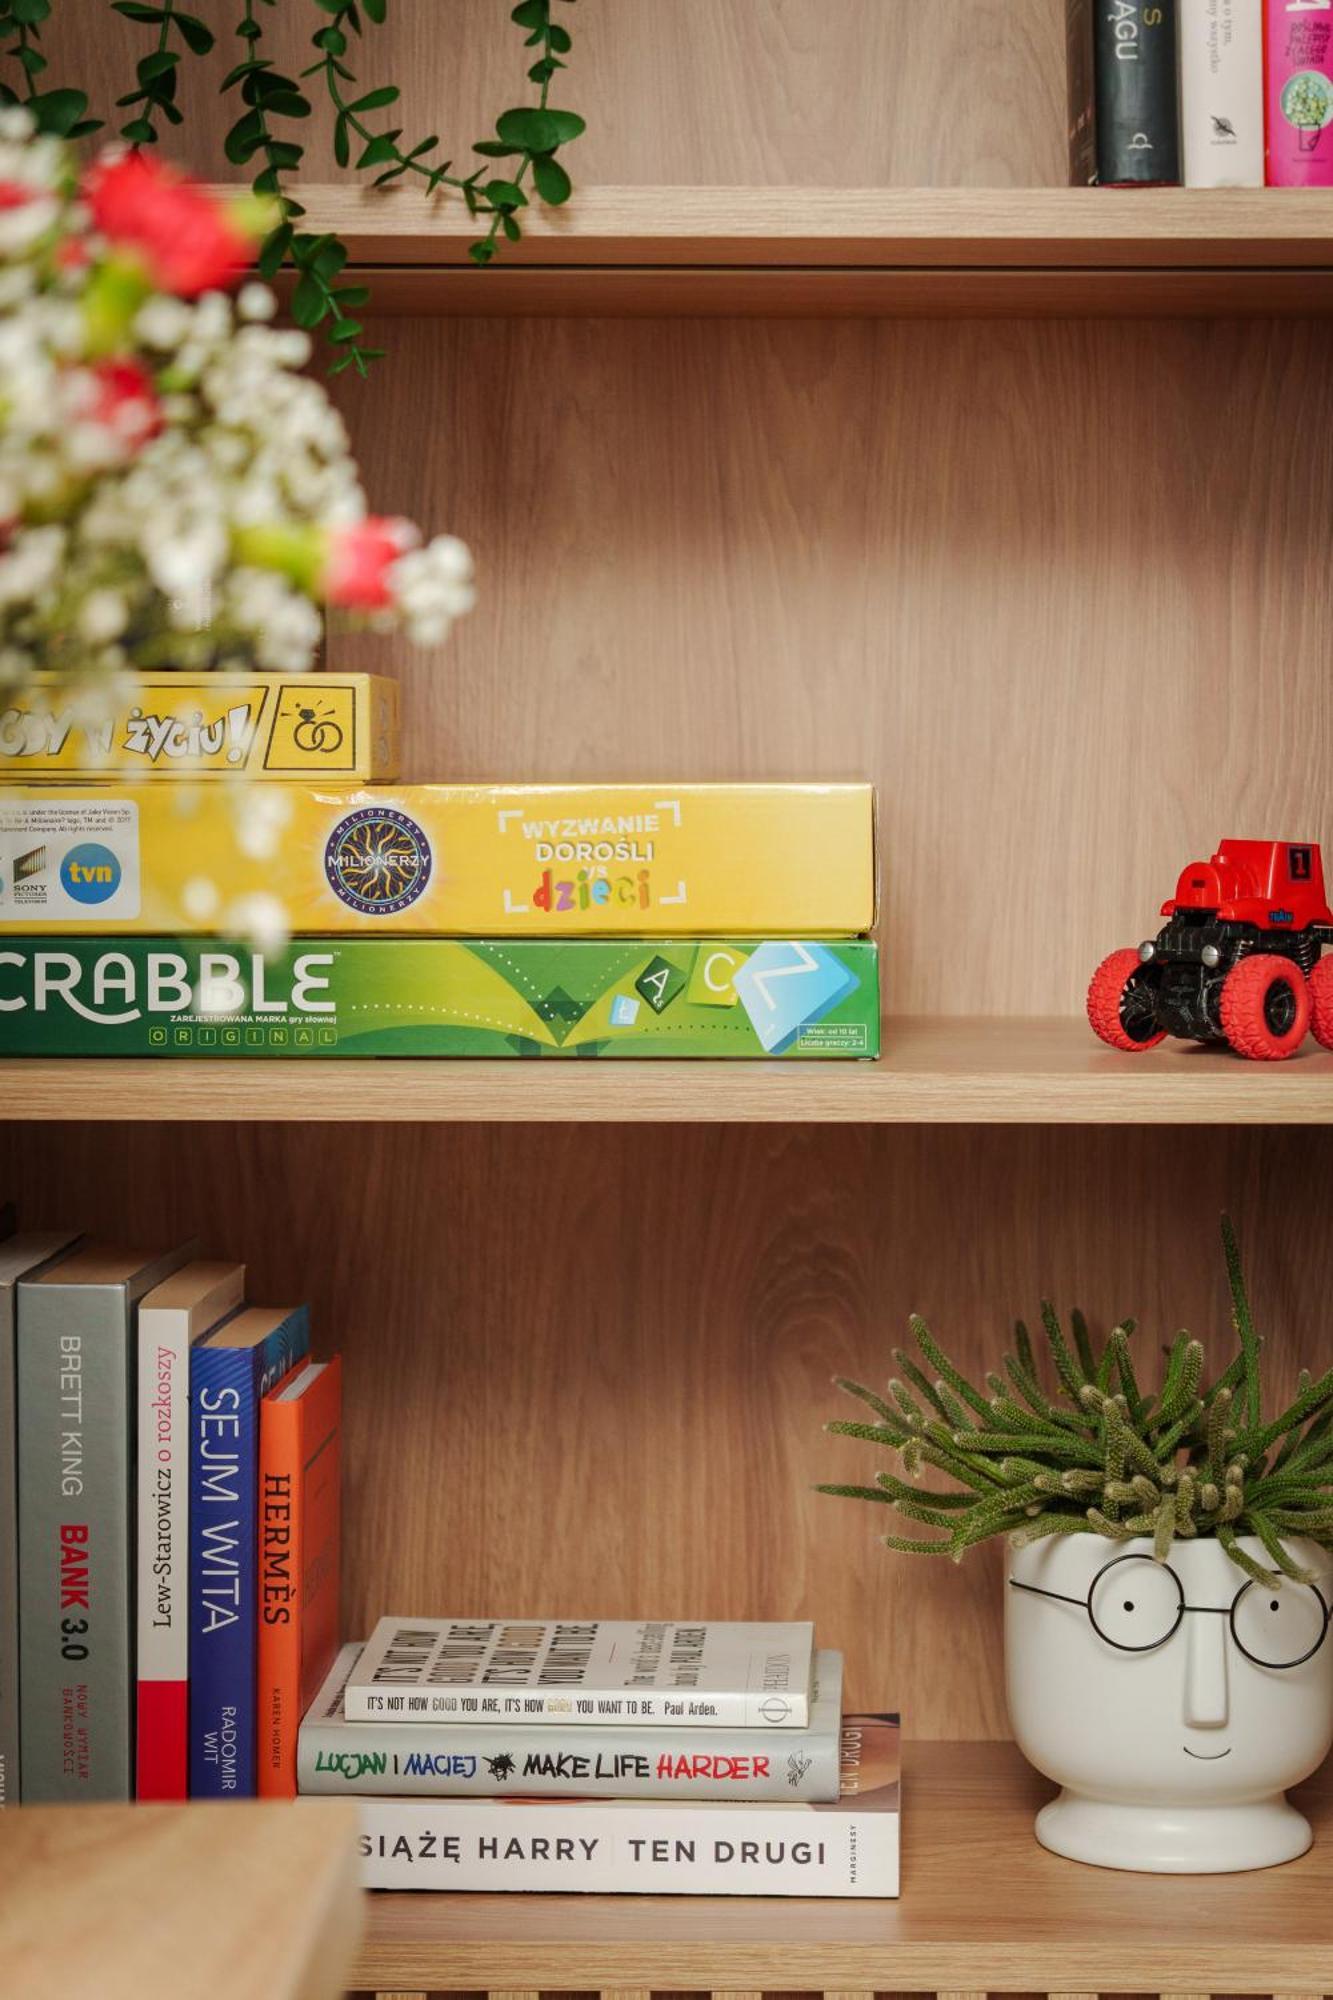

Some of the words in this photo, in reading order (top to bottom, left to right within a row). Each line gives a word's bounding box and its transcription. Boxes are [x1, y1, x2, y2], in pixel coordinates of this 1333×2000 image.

[336, 809, 420, 835] MILIONERZY
[522, 814, 660, 839] WYZWANIE
[327, 855, 430, 867] MILIONERZY
[535, 836, 655, 862] DOROŚLI
[13, 884, 47, 892] SONY
[69, 862, 112, 883] tvn
[533, 868, 650, 912] dzieci
[337, 887, 421, 913] MILIONERZY
[255, 1015, 287, 1023] MARKA
[288, 1015, 303, 1025] gry
[60, 1335, 82, 1424] BRETT
[151, 1345, 177, 1443] rozkoszy
[158, 1449, 172, 1462] o
[200, 1388, 240, 1501] SEJM
[61, 1432, 83, 1496] KING
[152, 1468, 172, 1629] Lew-Starowicz
[263, 1473, 297, 1625] HERMÈS
[60, 1524, 89, 1610] BANK
[201, 1520, 240, 1634] WITA
[61, 1618, 89, 1661] 3.0
[381, 1649, 431, 1665] NOT
[437, 1644, 488, 1660] YOU
[536, 1668, 587, 1685] YOU
[77, 1684, 89, 1719] NOWY
[272, 1687, 281, 1725] KAREN
[367, 1697, 383, 1711] IT'S
[387, 1697, 404, 1711] NOT
[408, 1697, 428, 1711] HOW
[432, 1698, 457, 1712] GOOD
[461, 1698, 478, 1712] YOU
[482, 1699, 500, 1714] ARE,
[504, 1699, 521, 1713] IT'S
[524, 1699, 544, 1713] HOW
[576, 1700, 594, 1714] YOU
[598, 1700, 622, 1715] WANT
[626, 1700, 638, 1714] TO
[641, 1701, 656, 1715] BE.
[664, 1701, 684, 1716] Paul
[688, 1701, 718, 1717] Arden.
[62, 1687, 75, 1775] BANKOWOŚCI
[204, 1731, 219, 1764] WIT
[221, 1706, 237, 1790] RADOMIR
[77, 1727, 89, 1782] WYMIAR
[273, 1729, 281, 1769] HOMER
[315, 1751, 387, 1779] LUCJAN
[403, 1752, 477, 1778] MACIEJ
[522, 1752, 591, 1778] MAKE
[594, 1753, 650, 1778] LIFE
[655, 1753, 770, 1781] HARDER
[357, 1830, 461, 1864] SIĄŻĘ
[479, 1837, 600, 1862] HARRY
[628, 1839, 695, 1863] TEN
[714, 1841, 825, 1865] DRUGI
[849, 1824, 858, 1884] MARGINESY
